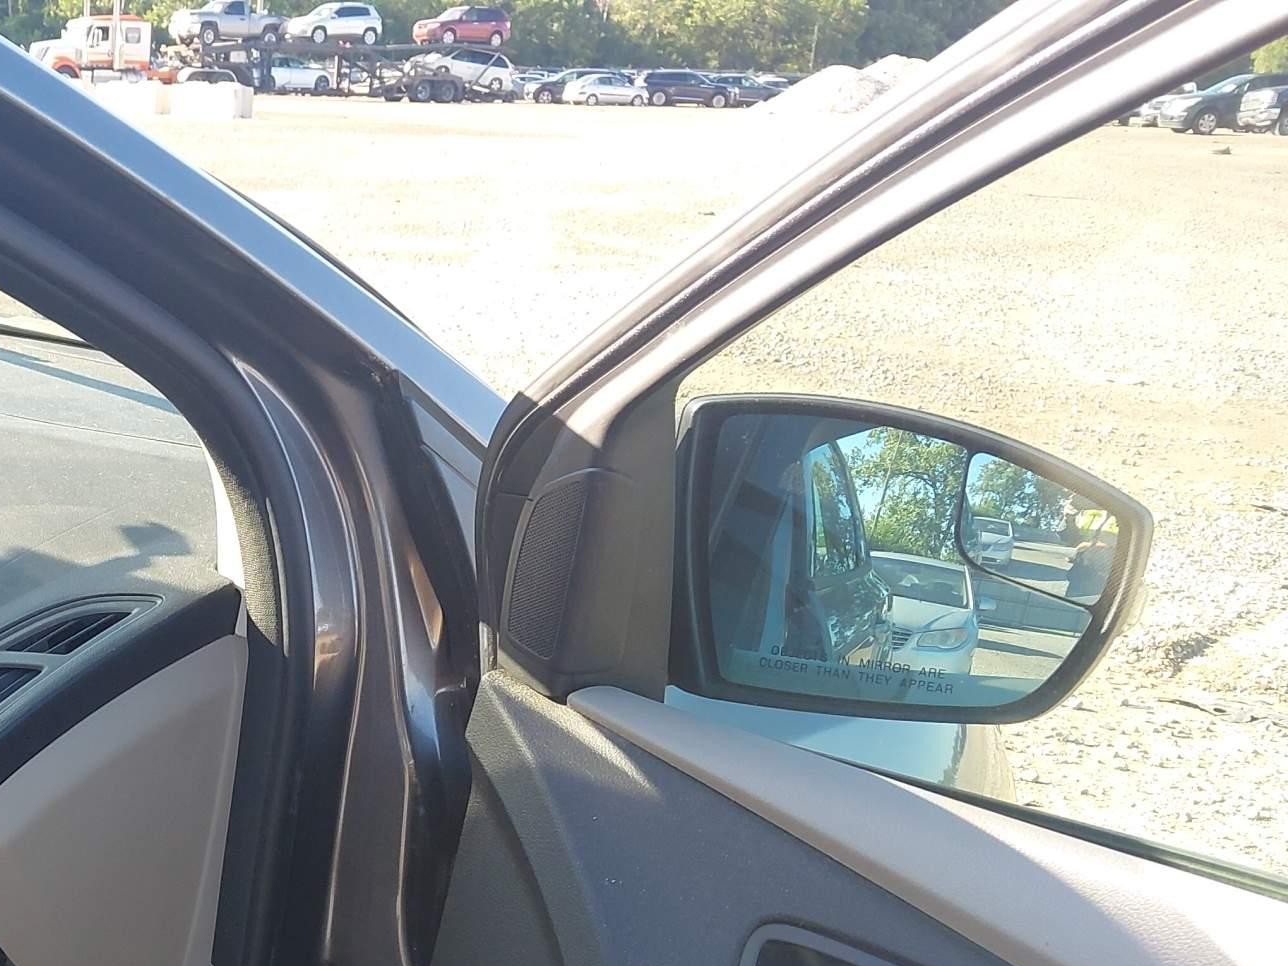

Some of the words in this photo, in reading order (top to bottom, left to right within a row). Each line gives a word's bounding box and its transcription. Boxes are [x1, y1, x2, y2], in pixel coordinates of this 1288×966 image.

[759, 656, 808, 674] CLOSER
[816, 665, 850, 680] THAN
[858, 671, 892, 686] THEY
[899, 678, 954, 694] APPEAR
[838, 655, 850, 667] IN
[859, 658, 911, 674] MIRROR
[918, 667, 946, 680] ARE
